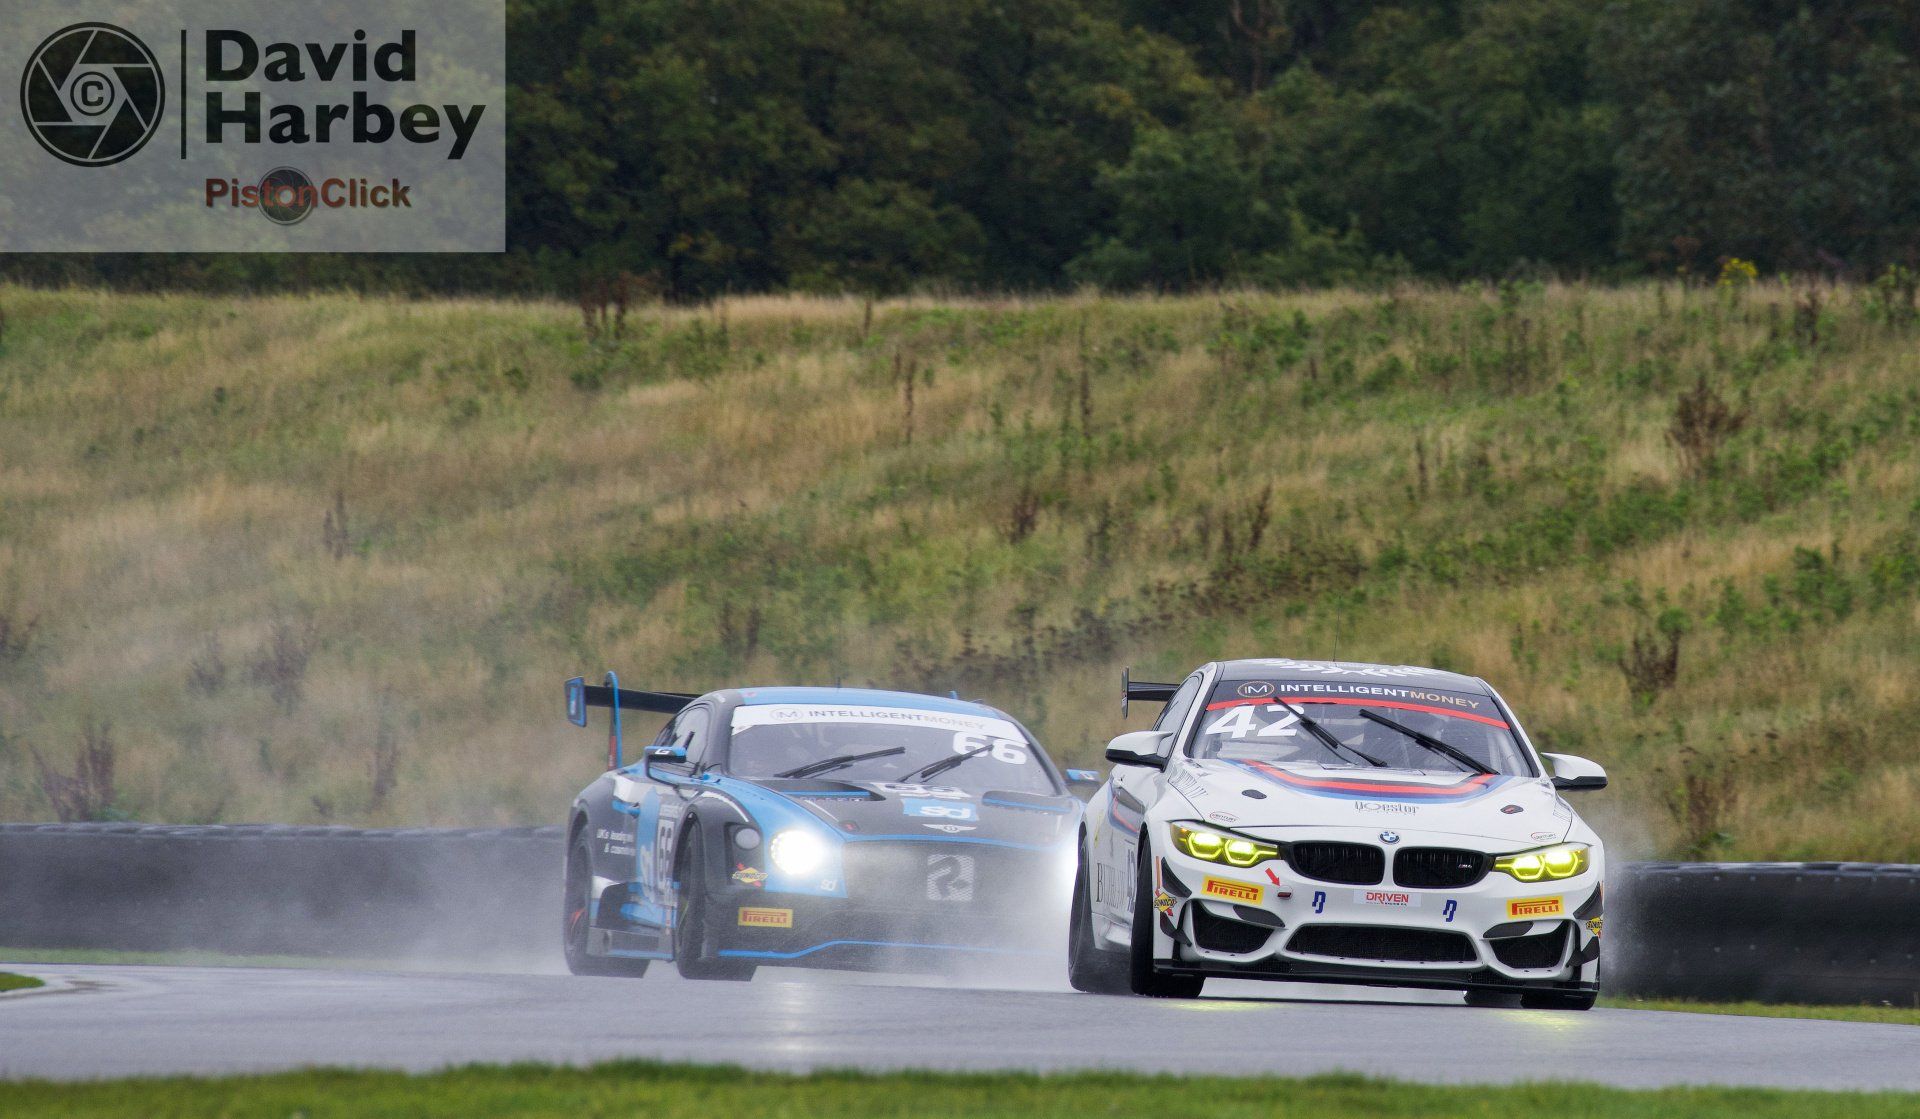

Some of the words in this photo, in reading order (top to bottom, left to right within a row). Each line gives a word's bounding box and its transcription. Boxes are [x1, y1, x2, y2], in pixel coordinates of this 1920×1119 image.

[1280, 683, 1480, 710] INTELLIGENTMONEY
[808, 709, 986, 730] INTELLIGENTMONEY
[1205, 704, 1304, 739] 42
[952, 730, 1028, 766] 66
[1207, 880, 1259, 900] PIRELLI
[1366, 892, 1409, 904] DRIVEN
[742, 910, 788, 924] PIRELLI
[1511, 899, 1560, 916] PIRELLI
